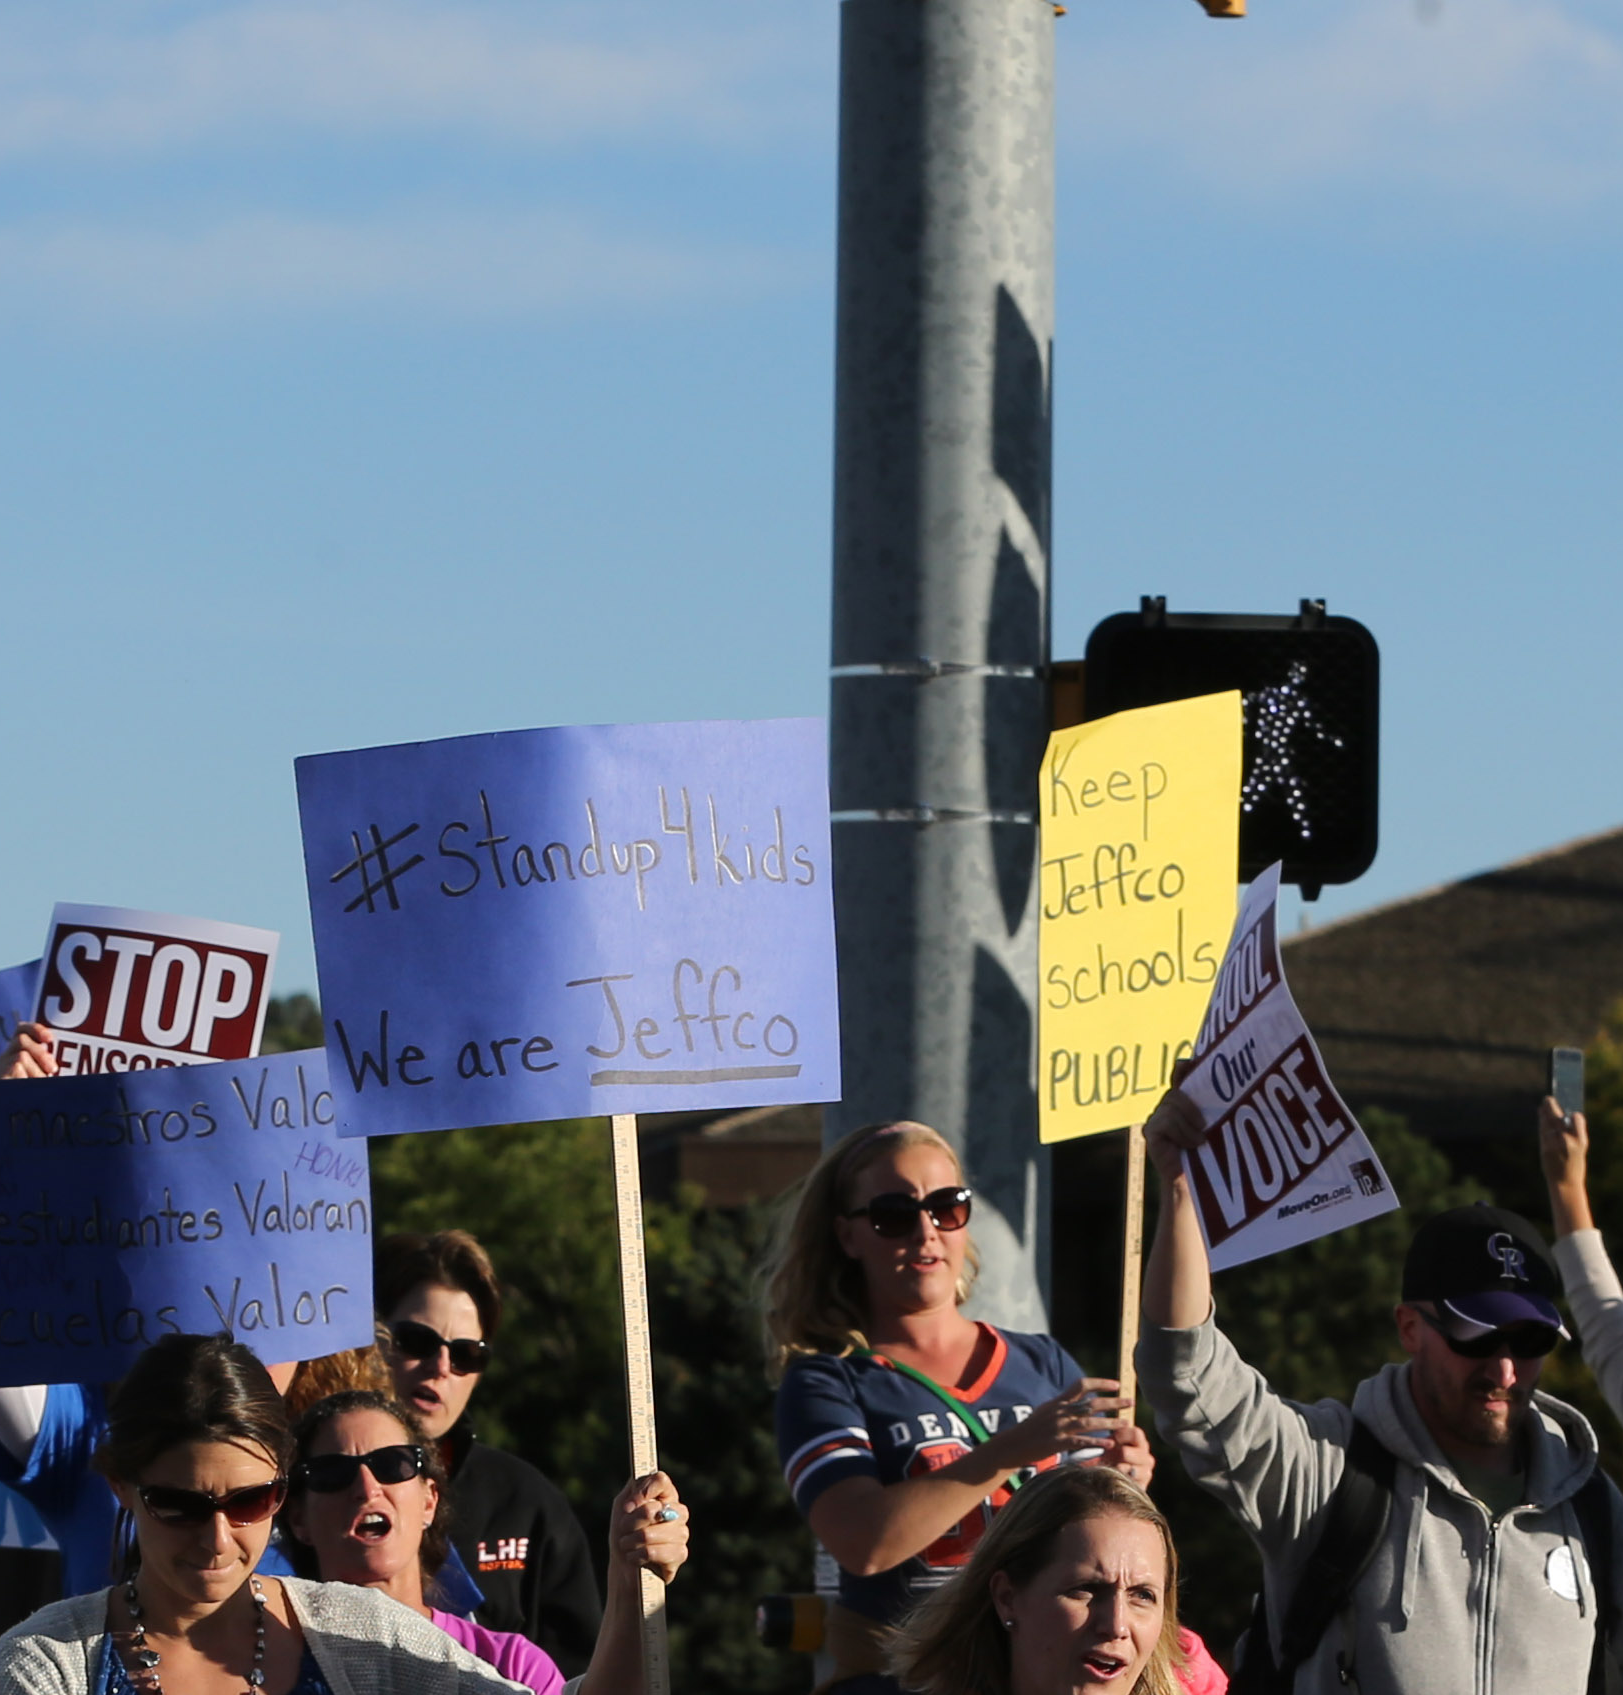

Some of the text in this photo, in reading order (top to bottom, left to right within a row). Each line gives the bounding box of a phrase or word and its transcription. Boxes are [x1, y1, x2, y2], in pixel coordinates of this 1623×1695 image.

[1050, 737, 1167, 843] Keep
[329, 785, 816, 914] #Standup4kids
[1041, 842, 1185, 919] Jeffco
[44, 931, 253, 1054] STOP
[334, 957, 799, 1094] We are Jeffco
[231, 1065, 335, 1130] Valo
[1211, 1037, 1256, 1103] Our
[1187, 1047, 1348, 1230] VOICE
[232, 1170, 367, 1236] Valoran
[203, 1261, 350, 1331] Valor
[888, 1404, 1033, 1447] DENVE
